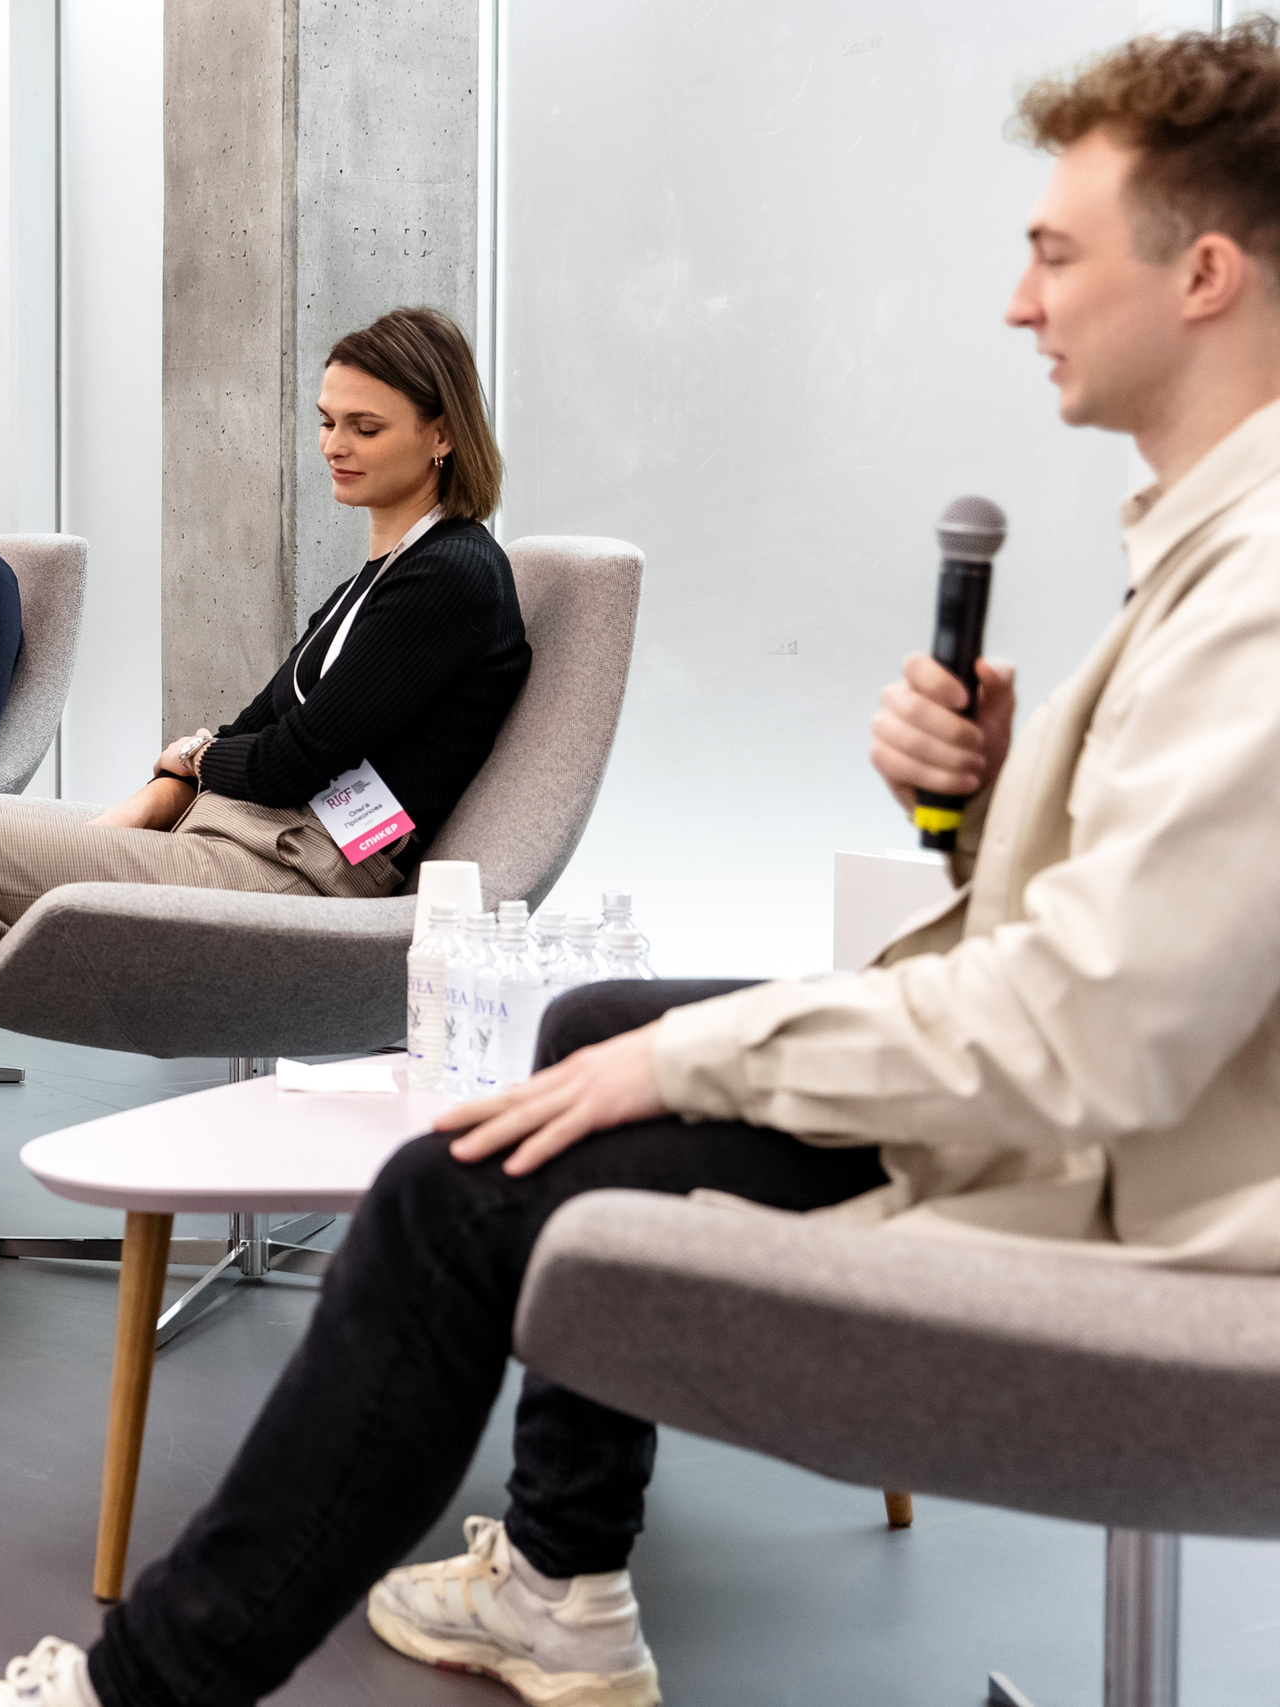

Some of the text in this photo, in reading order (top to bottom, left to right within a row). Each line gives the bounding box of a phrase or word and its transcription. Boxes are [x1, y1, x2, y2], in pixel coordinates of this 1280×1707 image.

[326, 787, 352, 810] RIGF
[348, 802, 370, 818] Ольга
[344, 803, 383, 829] Прокопова
[358, 823, 399, 852] СПИКЕР
